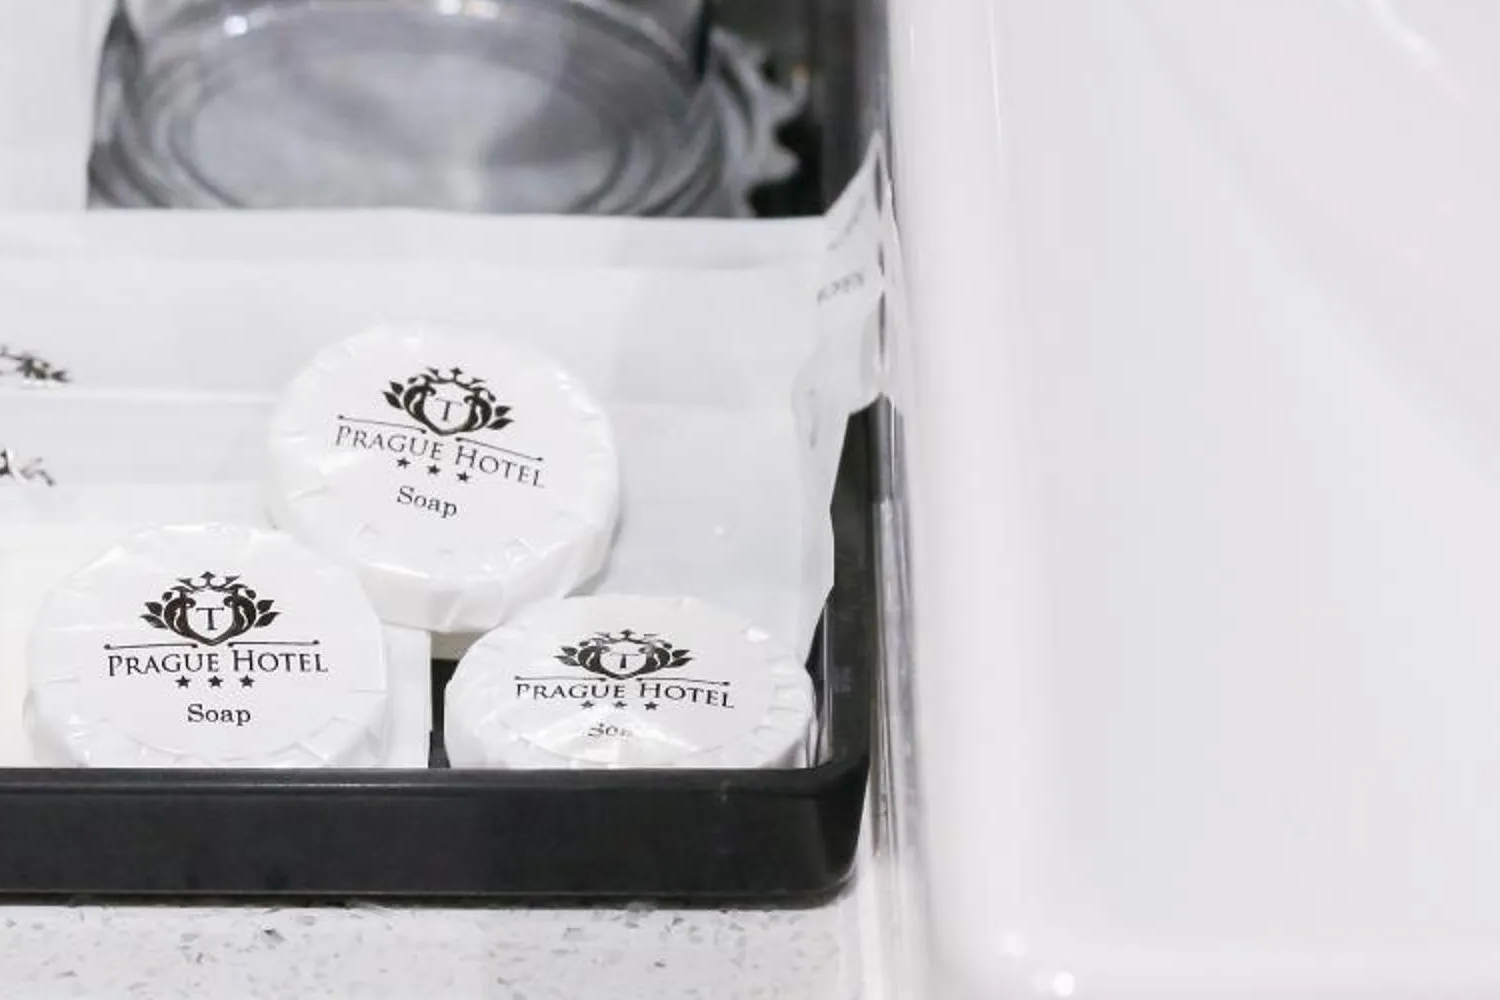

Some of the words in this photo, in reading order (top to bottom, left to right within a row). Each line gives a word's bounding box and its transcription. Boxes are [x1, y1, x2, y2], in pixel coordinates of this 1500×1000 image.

[334, 424, 445, 462] PRAGUE
[453, 444, 546, 490] HOTEL
[396, 484, 459, 519] Soap
[195, 606, 226, 631] T
[106, 652, 221, 678] PRAGUE
[230, 649, 329, 673] HOTEL
[515, 682, 626, 701] PRAGUE
[638, 681, 735, 709] HOTEL
[186, 703, 252, 727] Soap
[587, 721, 634, 740] So
